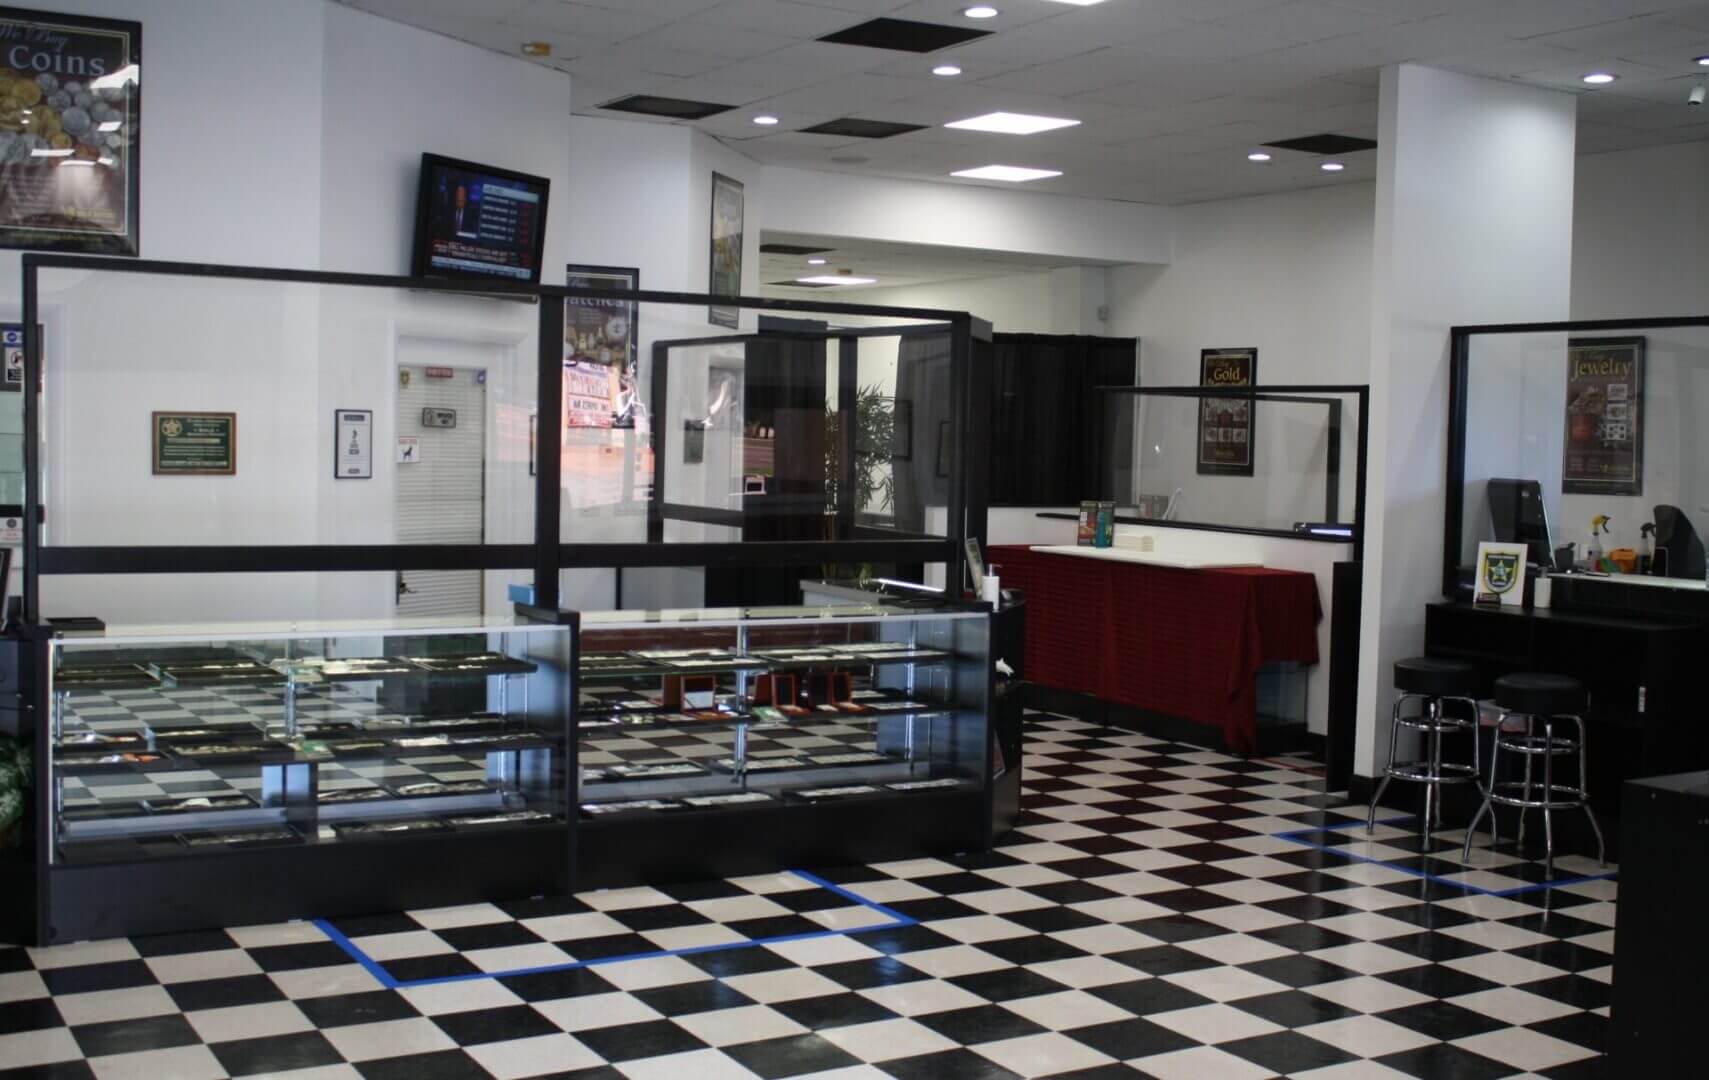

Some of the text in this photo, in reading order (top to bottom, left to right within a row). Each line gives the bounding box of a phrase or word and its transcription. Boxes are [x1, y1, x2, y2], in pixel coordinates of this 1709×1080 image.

[9, 45, 105, 76] Coins
[1214, 367, 1241, 381] Gold
[1570, 358, 1633, 382] Jewelry
